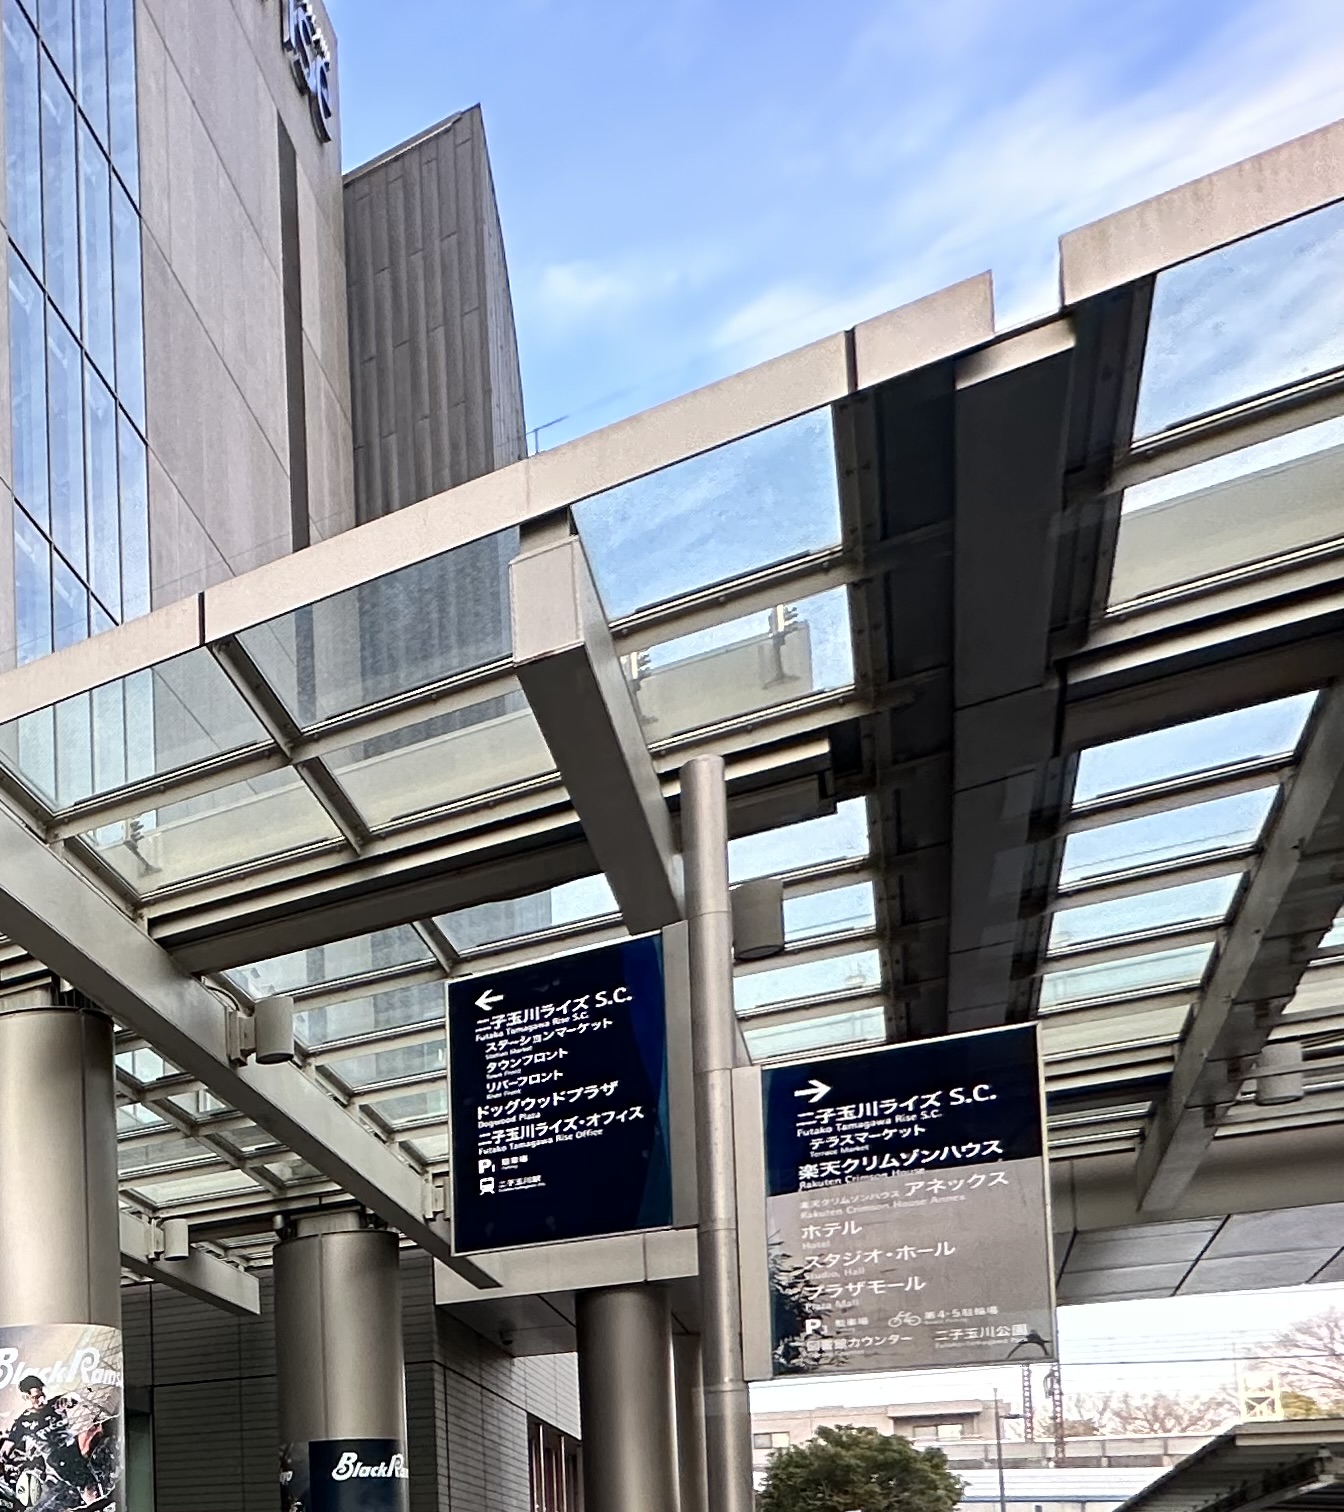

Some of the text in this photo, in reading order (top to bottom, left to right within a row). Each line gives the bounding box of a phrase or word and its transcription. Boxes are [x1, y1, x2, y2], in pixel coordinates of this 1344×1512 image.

[475, 987, 633, 1033] 二子玉川ライズ S.C.
[475, 1030, 504, 1042] Futako
[506, 1021, 550, 1036] Tamagawa
[552, 1016, 570, 1026] Rise
[485, 1018, 614, 1053] ステーションマーケット
[486, 1048, 569, 1074] タウンフロント
[486, 1070, 564, 1093] リバーフロント
[477, 1080, 619, 1120] ドッグウッドプラザ
[796, 1084, 998, 1127] 二子玉川ライズ S.C.
[477, 1105, 645, 1147] 二子玉川ライズ・オフィス
[478, 1116, 517, 1129] Dogwood
[796, 1125, 833, 1138] Futako
[835, 1117, 892, 1133] Tamagawa
[895, 1113, 918, 1124] Rise
[478, 1144, 507, 1155] Futako
[509, 1136, 553, 1150] Tamagawa
[555, 1132, 573, 1142] Rise
[809, 1123, 927, 1151] テラスマーケット
[798, 1140, 1004, 1180] 楽天クリムゾンハウス
[799, 1175, 842, 1190] Rakuten
[904, 1171, 1009, 1197] アネックス
[801, 1220, 863, 1240] ホテル
[804, 1241, 957, 1271] スタジオ・ホール
